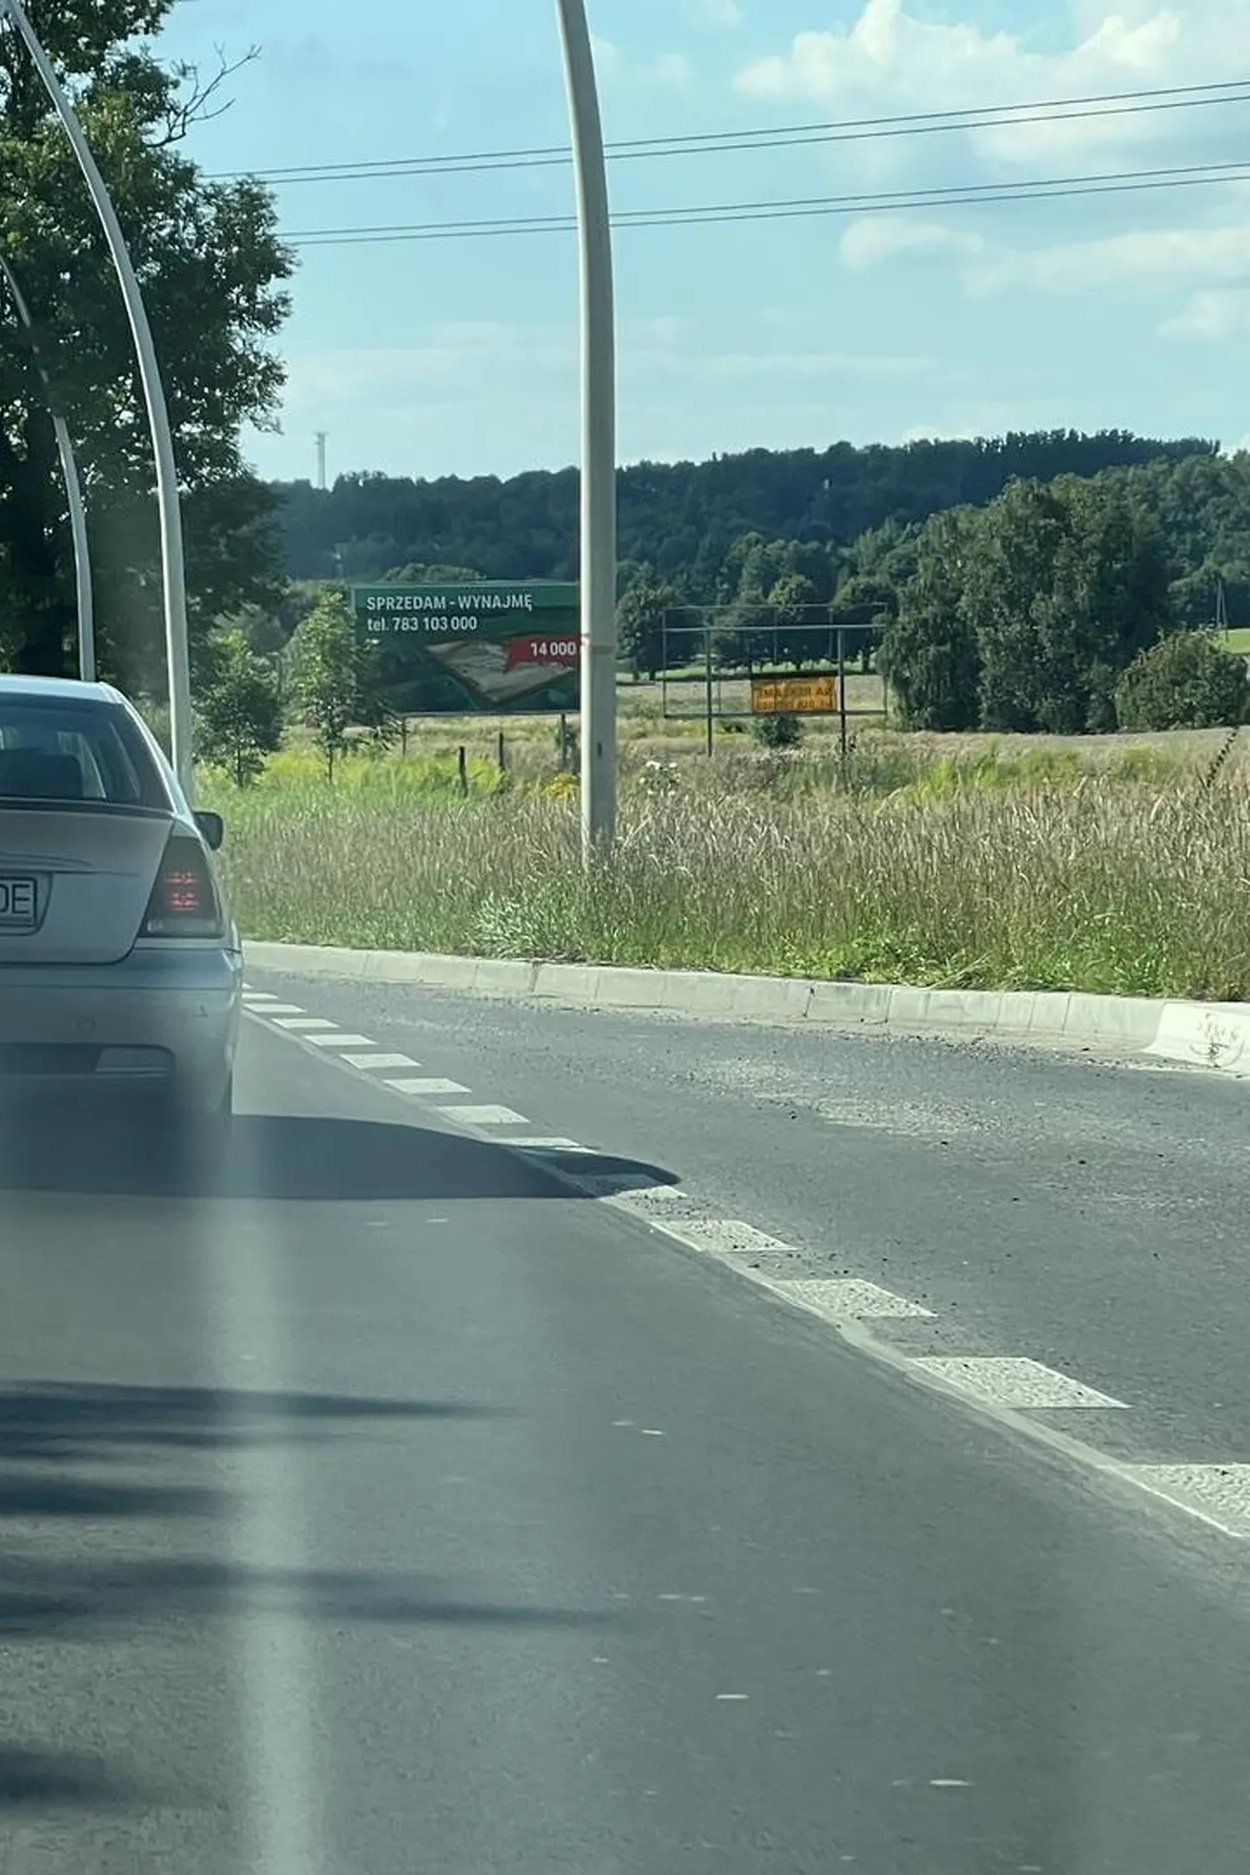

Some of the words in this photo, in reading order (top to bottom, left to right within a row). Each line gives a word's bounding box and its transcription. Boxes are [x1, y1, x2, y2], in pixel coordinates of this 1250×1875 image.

[366, 596, 446, 611] SPRZEDAM
[457, 594, 532, 612] WYNAJMĘ
[367, 617, 389, 631] tel.
[392, 617, 419, 631] 783
[423, 616, 448, 631] 103
[450, 616, 478, 631] 000
[530, 642, 548, 657] 14
[550, 642, 577, 656] 000
